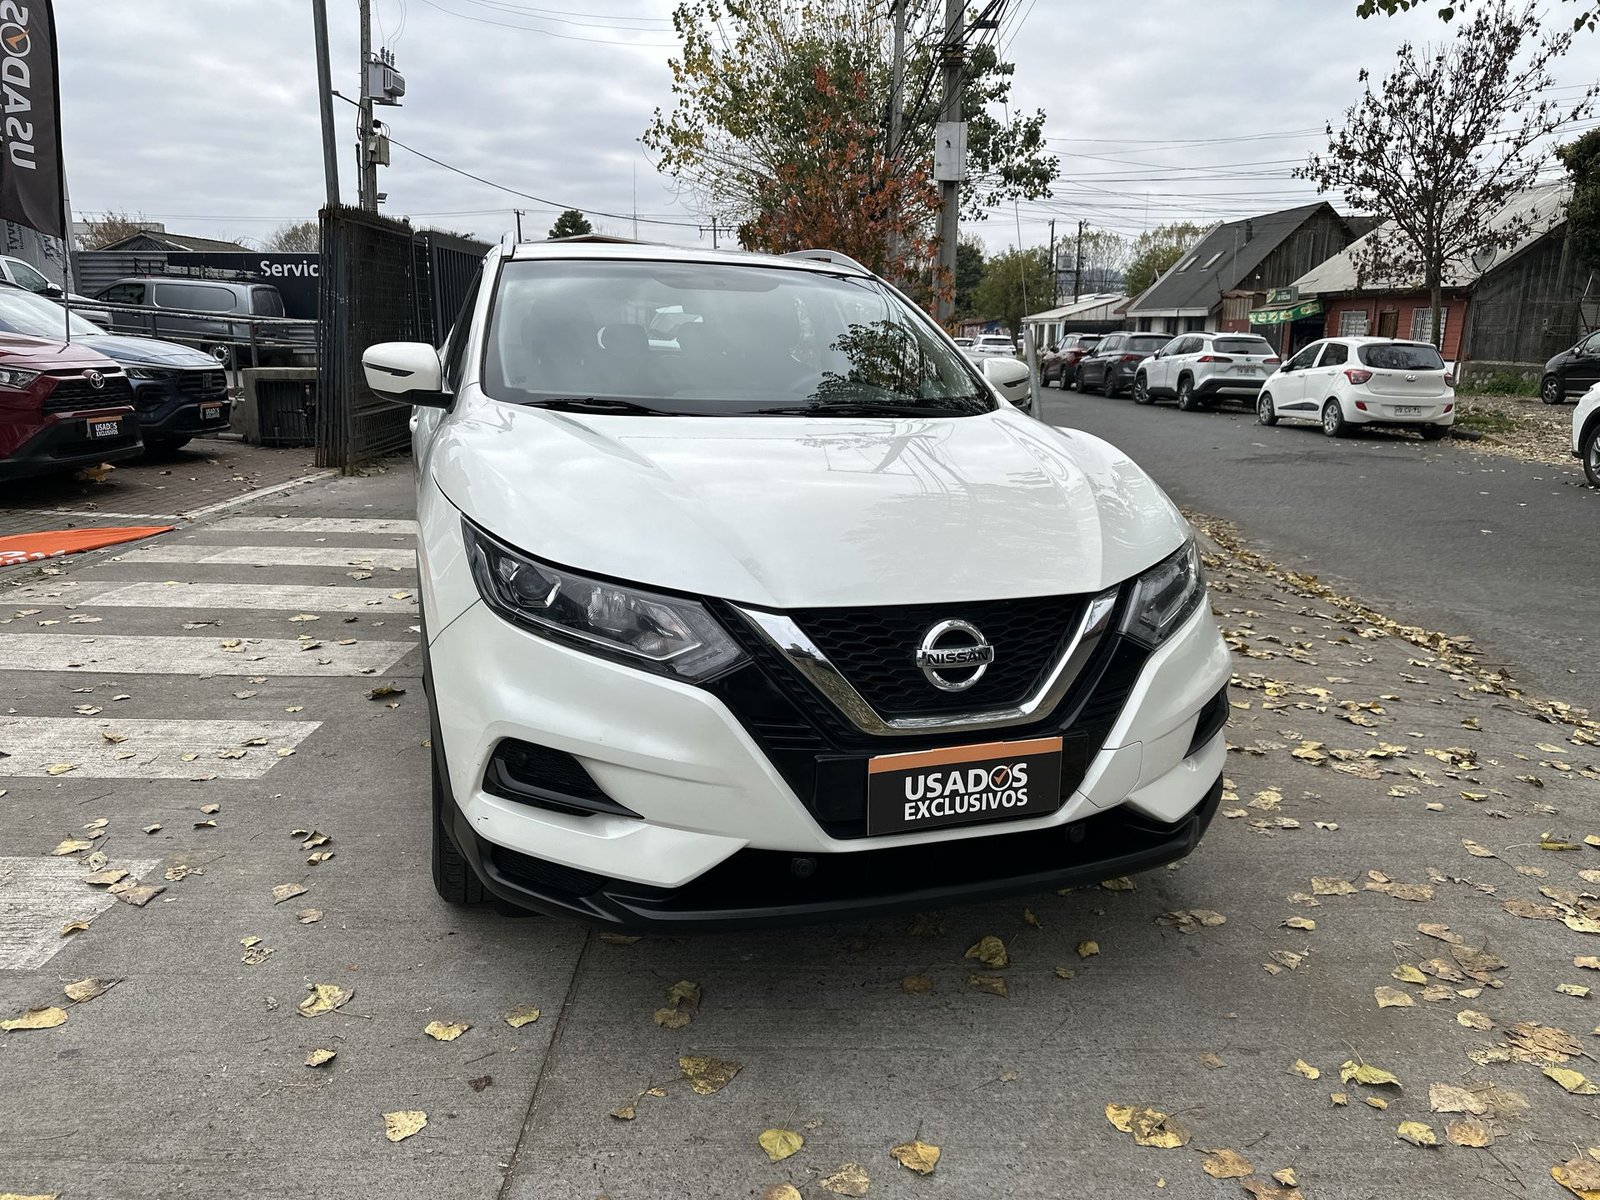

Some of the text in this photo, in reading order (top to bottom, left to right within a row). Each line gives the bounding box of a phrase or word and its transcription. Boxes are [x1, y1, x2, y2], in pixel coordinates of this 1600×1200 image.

[7, 221, 19, 252] Tyve
[260, 260, 319, 277] Servic
[95, 422, 117, 432] USADOS
[927, 647, 990, 666] NISSAN
[905, 762, 1028, 801] USADOS
[904, 788, 1028, 821] EXCLUSIVOS
